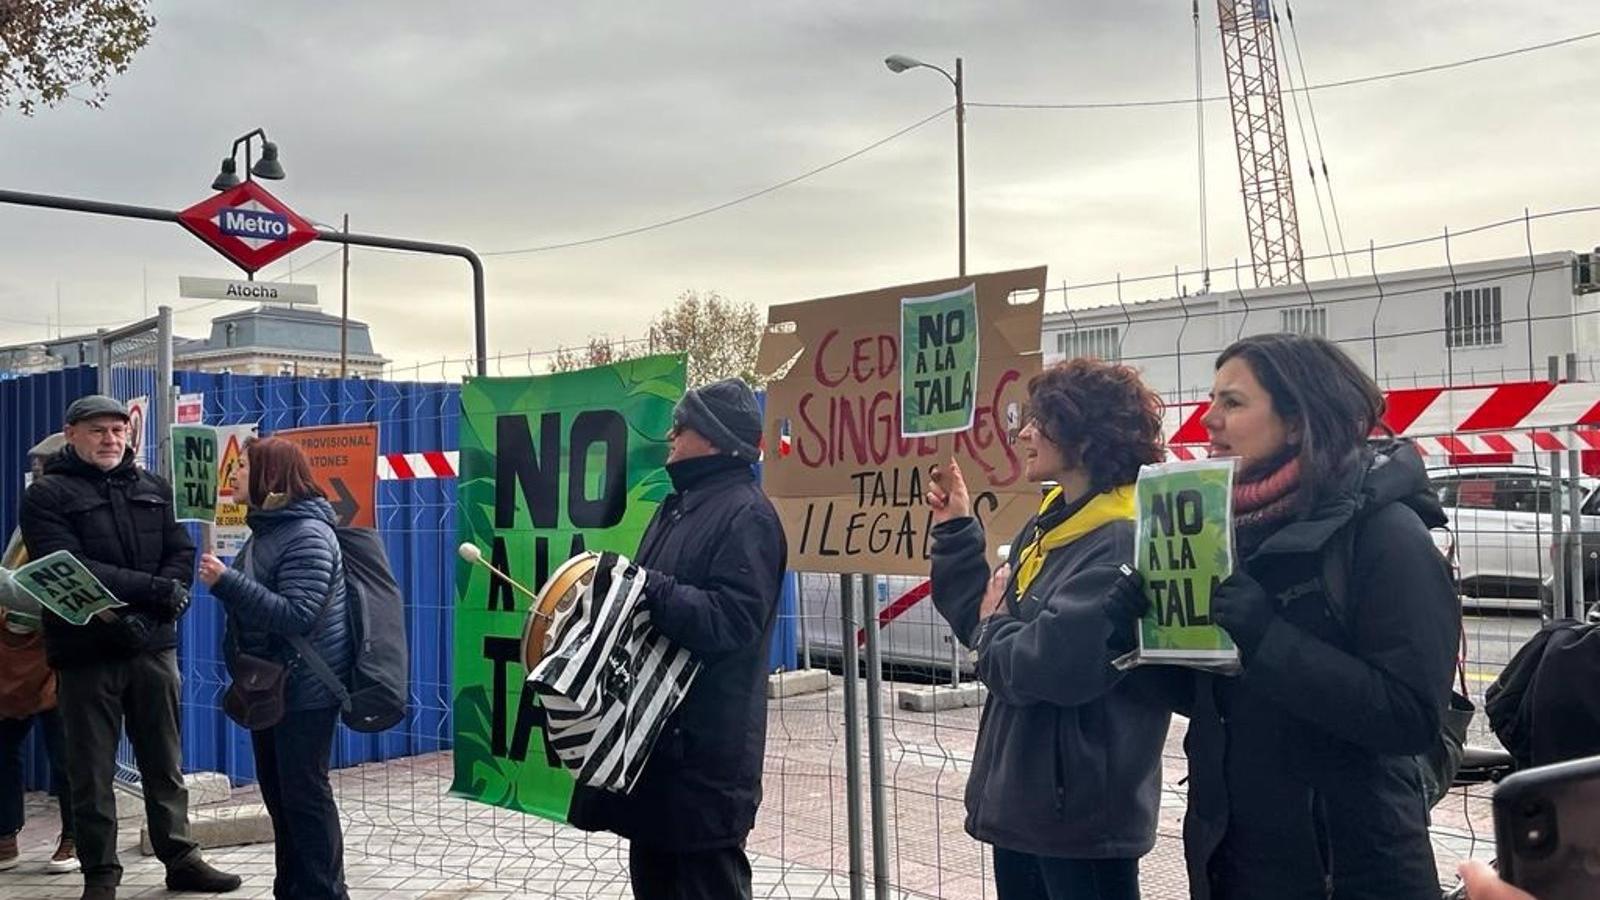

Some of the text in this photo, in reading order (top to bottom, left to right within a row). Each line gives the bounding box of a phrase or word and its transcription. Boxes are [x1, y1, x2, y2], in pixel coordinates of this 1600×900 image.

[226, 212, 284, 235] Metro
[226, 283, 278, 298] Atocha
[918, 309, 965, 349] NO
[814, 329, 899, 388] CED
[916, 346, 955, 374] A LA
[914, 371, 972, 416] TALA
[185, 436, 213, 463] NO
[301, 434, 372, 449] PROVISIONAL
[185, 463, 208, 479] A LA
[495, 409, 628, 529] NO
[800, 491, 999, 560] ILEGALS
[1151, 489, 1204, 538] NO
[1149, 537, 1197, 571] A LA
[29, 561, 76, 588] NO
[45, 578, 82, 599] A LA
[488, 536, 516, 612] A
